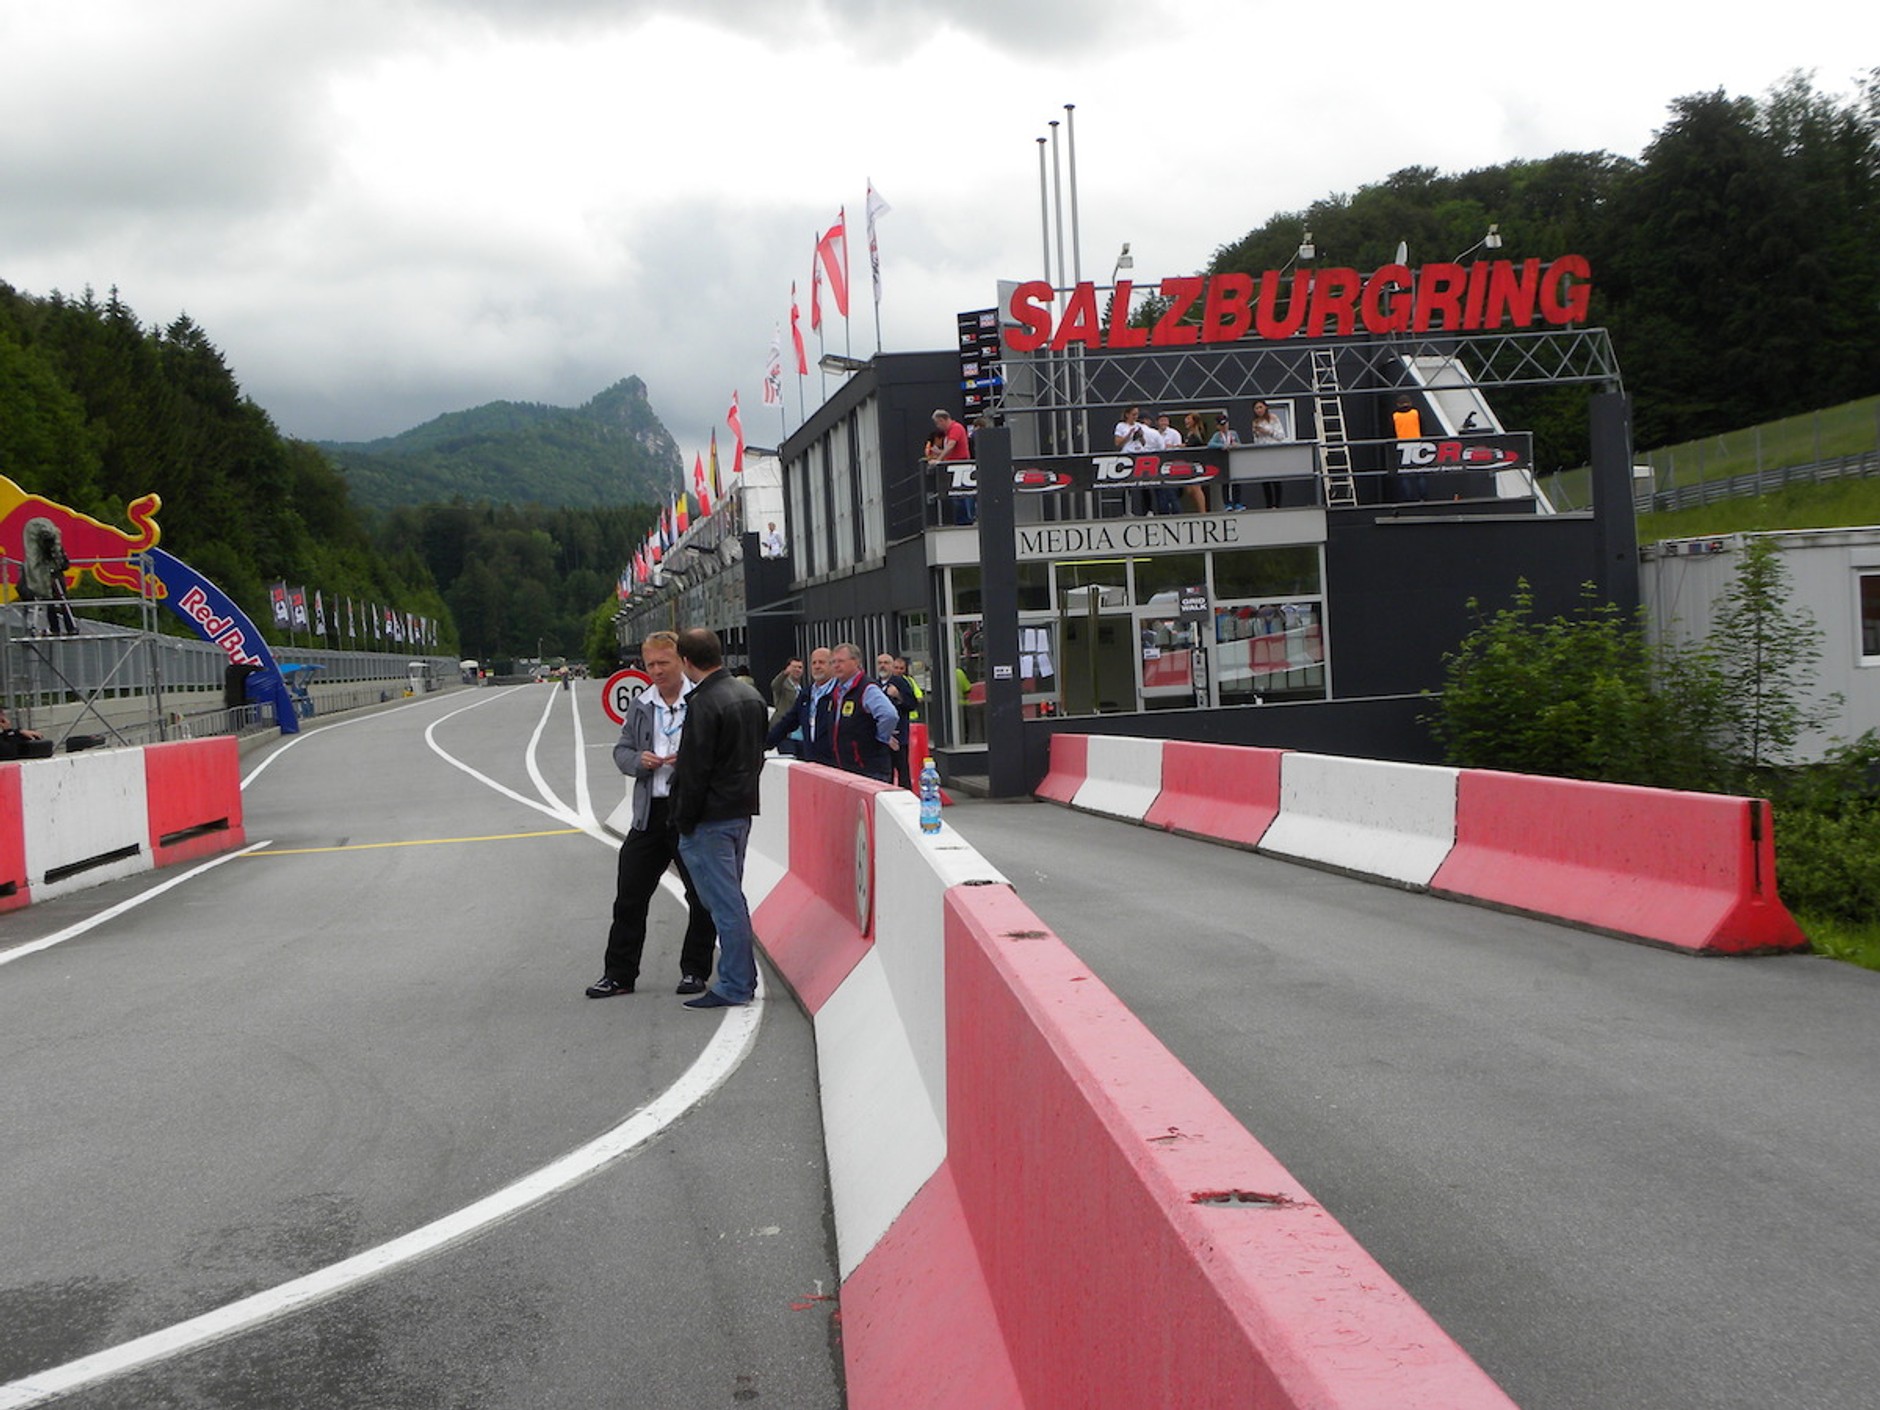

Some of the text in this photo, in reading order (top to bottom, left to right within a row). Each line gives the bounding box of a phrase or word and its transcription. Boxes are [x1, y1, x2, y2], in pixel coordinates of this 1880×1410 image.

[1004, 254, 1592, 352] SALZBURGRING
[1395, 441, 1463, 465] TCR
[947, 464, 977, 488] TC
[1092, 456, 1161, 480] TCR
[1020, 518, 1239, 554] MEDIA CENTRE
[178, 585, 234, 638] Red
[1181, 597, 1206, 605] GRID
[1181, 603, 1207, 611] WALK
